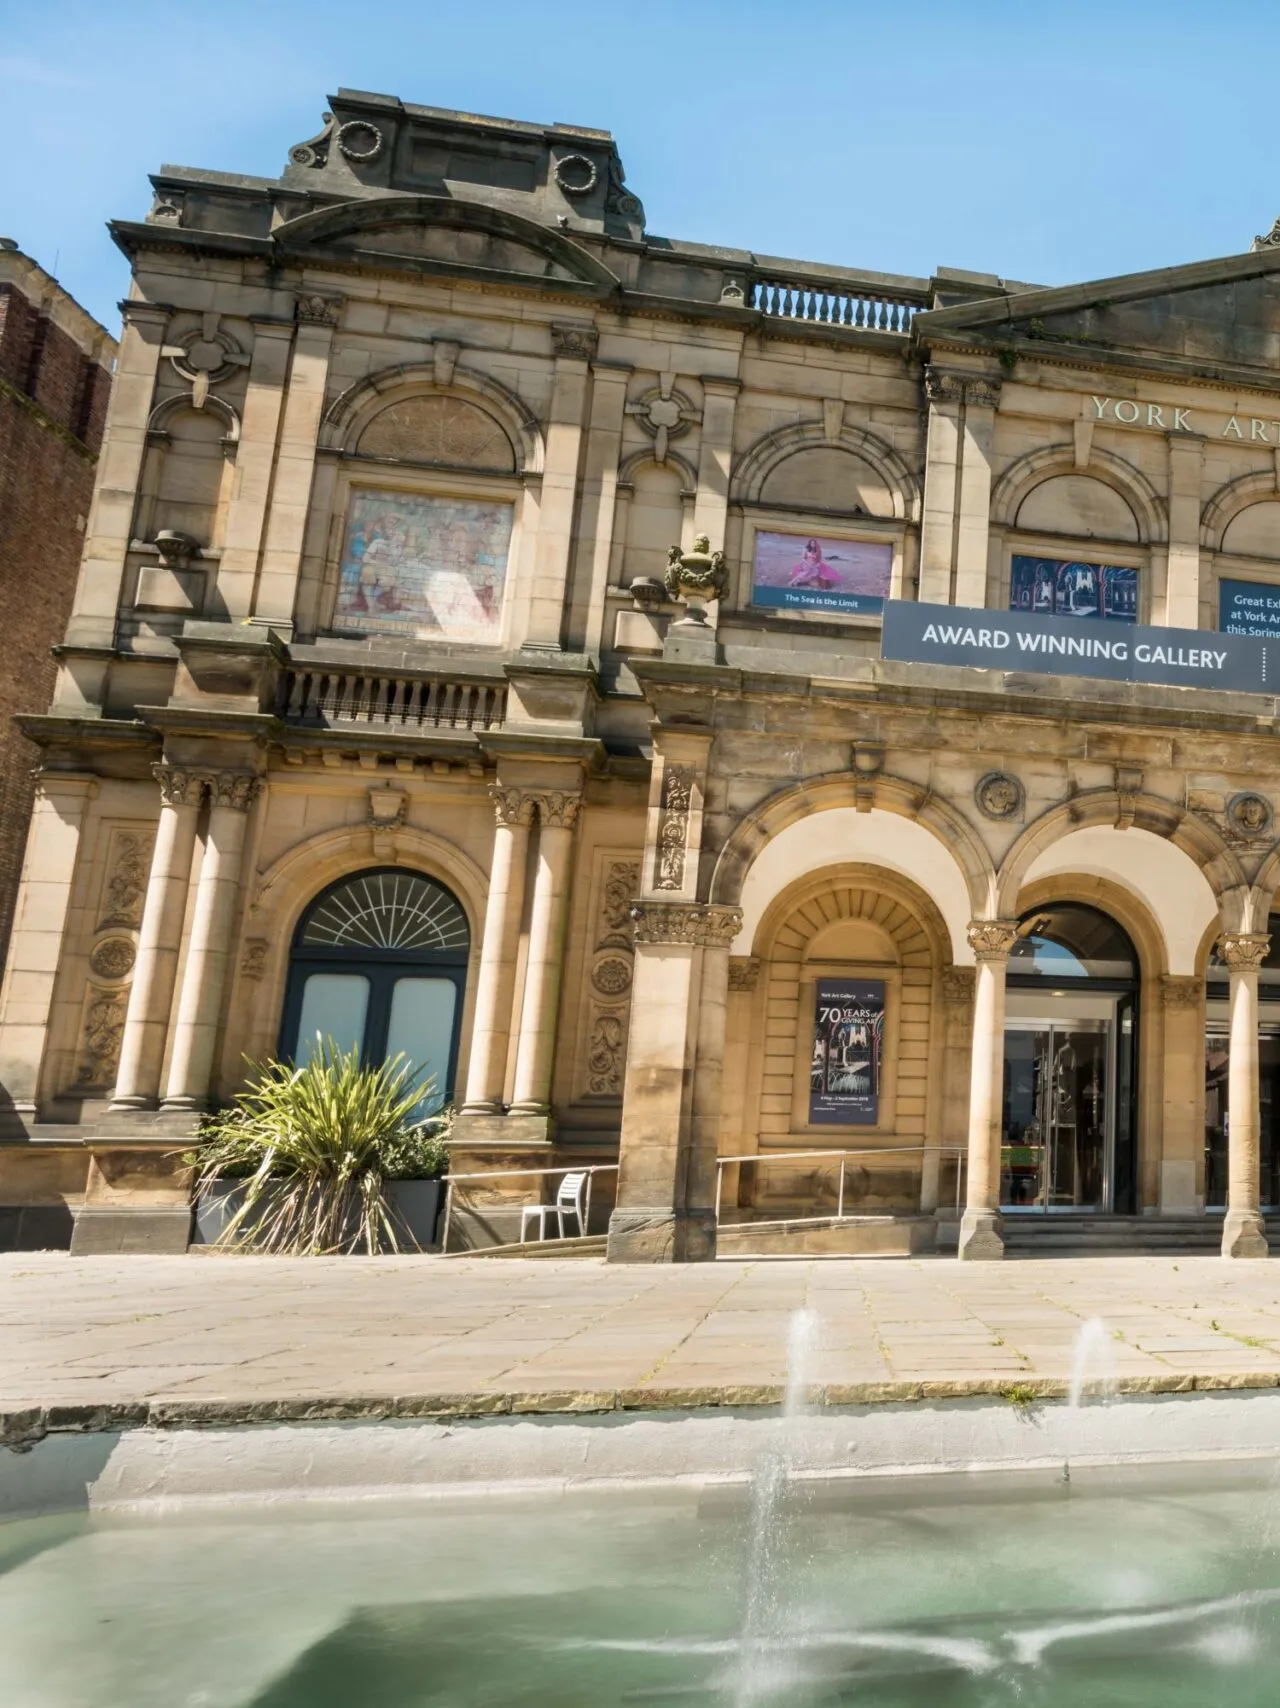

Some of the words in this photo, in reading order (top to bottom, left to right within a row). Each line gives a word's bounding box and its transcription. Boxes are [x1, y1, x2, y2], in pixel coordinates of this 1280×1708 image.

[1091, 395, 1193, 432] YORK
[785, 594, 799, 602] The
[801, 595, 815, 604] Sea
[816, 596, 823, 605] is
[824, 598, 837, 606] the
[839, 599, 859, 608] Limit
[1234, 595, 1263, 606] Great
[1230, 611, 1242, 619] at
[1244, 611, 1266, 622] York
[1226, 624, 1246, 635] this
[922, 624, 1010, 650] AWARD
[1016, 633, 1128, 661] WINNING
[1134, 645, 1227, 670] GALLERY
[820, 1007, 841, 1023] 70
[842, 1008, 870, 1017] YEARS
